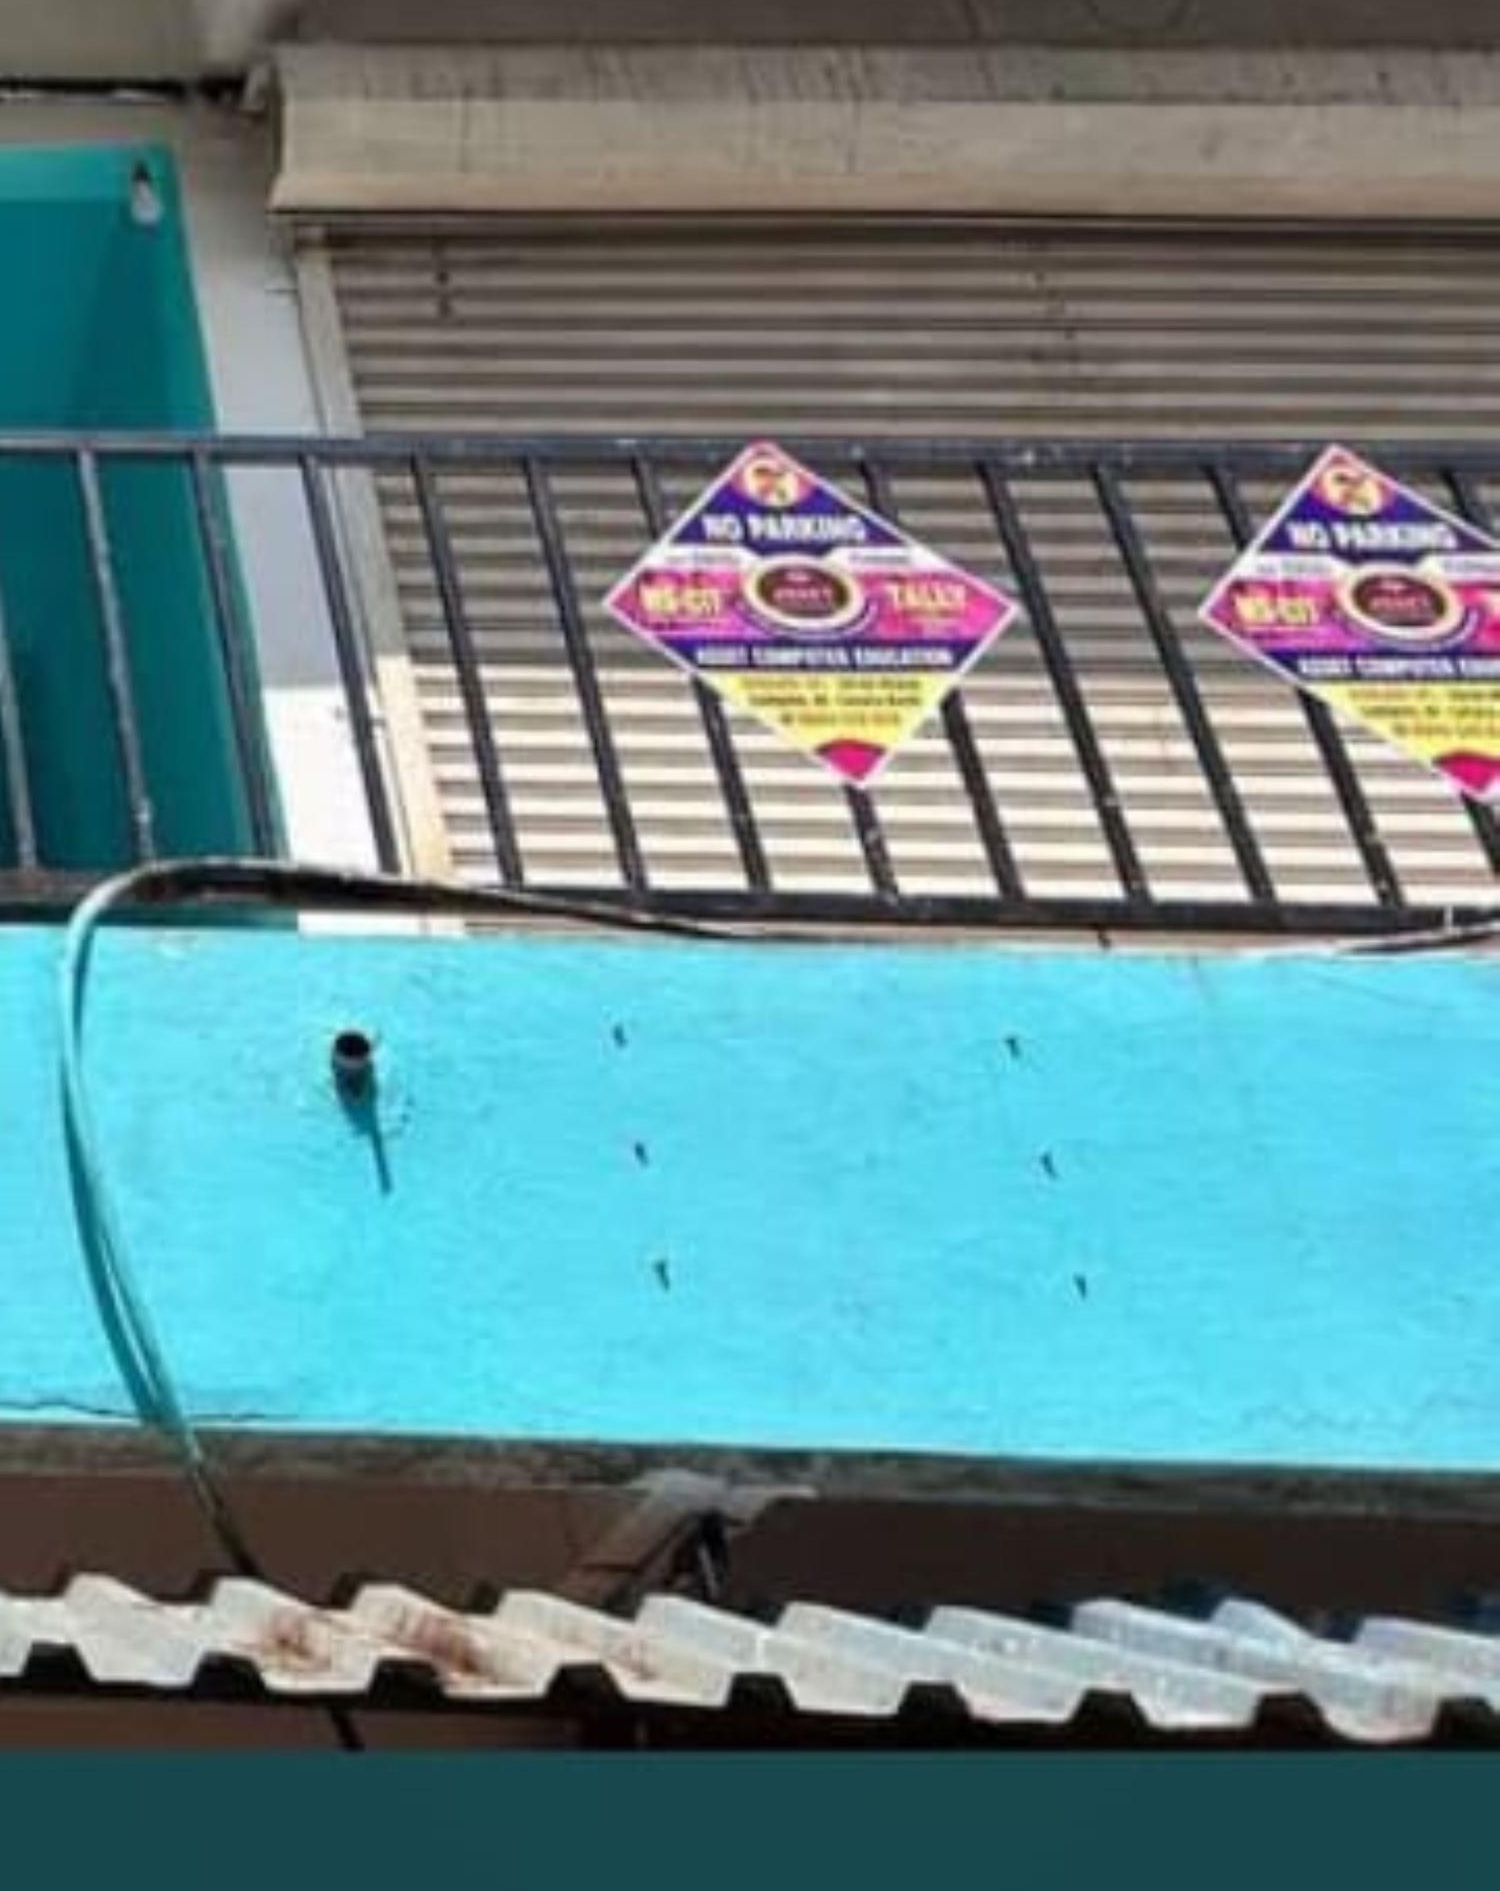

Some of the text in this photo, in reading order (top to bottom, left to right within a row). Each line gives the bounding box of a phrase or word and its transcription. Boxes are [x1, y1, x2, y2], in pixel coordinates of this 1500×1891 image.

[702, 514, 868, 542] NO PARKING
[1285, 521, 1460, 550] NO PARKING
[753, 646, 850, 667] COMPUTER
[855, 647, 954, 667] EDUCATION
[1355, 656, 1456, 677] COMPUTER
